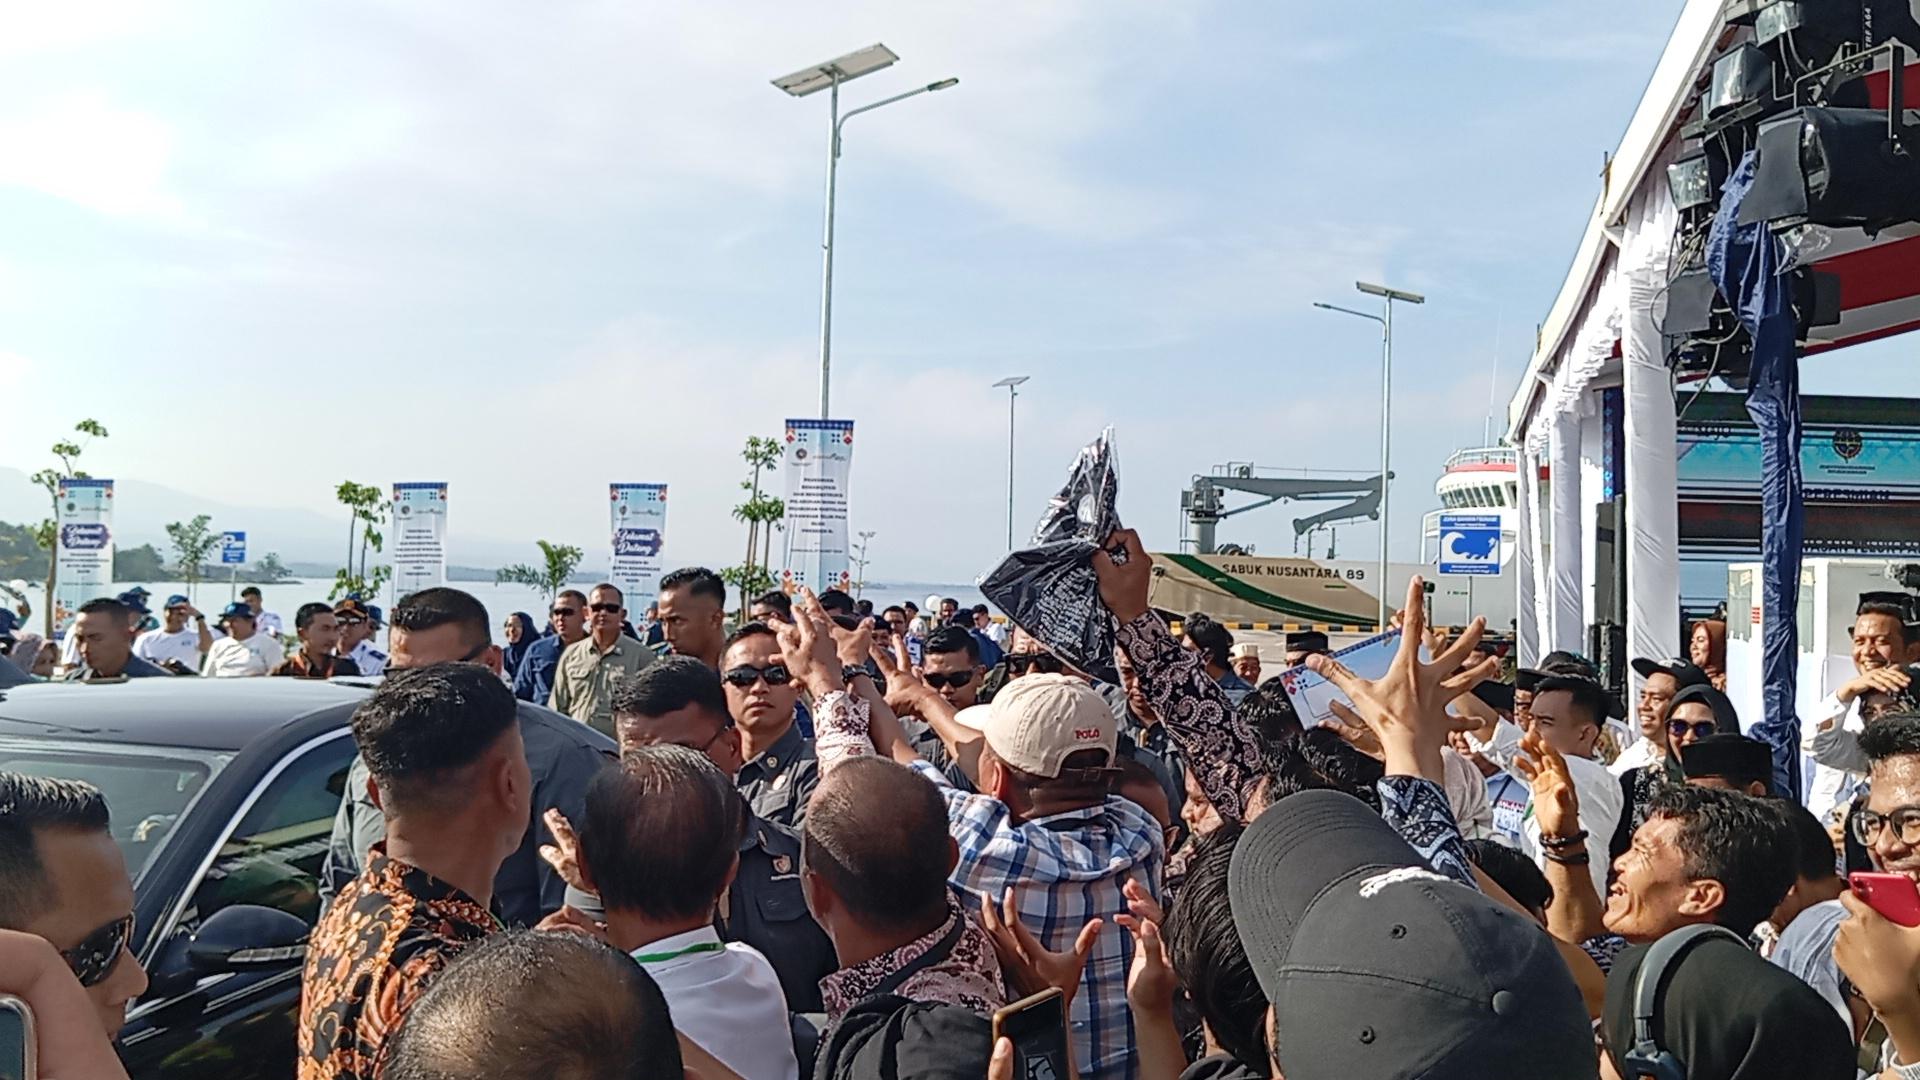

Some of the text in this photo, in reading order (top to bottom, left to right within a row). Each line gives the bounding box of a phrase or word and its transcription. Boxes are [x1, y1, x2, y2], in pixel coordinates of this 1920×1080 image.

[1222, 564, 1365, 580] SABUK NUSANTARA 89
[1075, 728, 1101, 740] POLO
